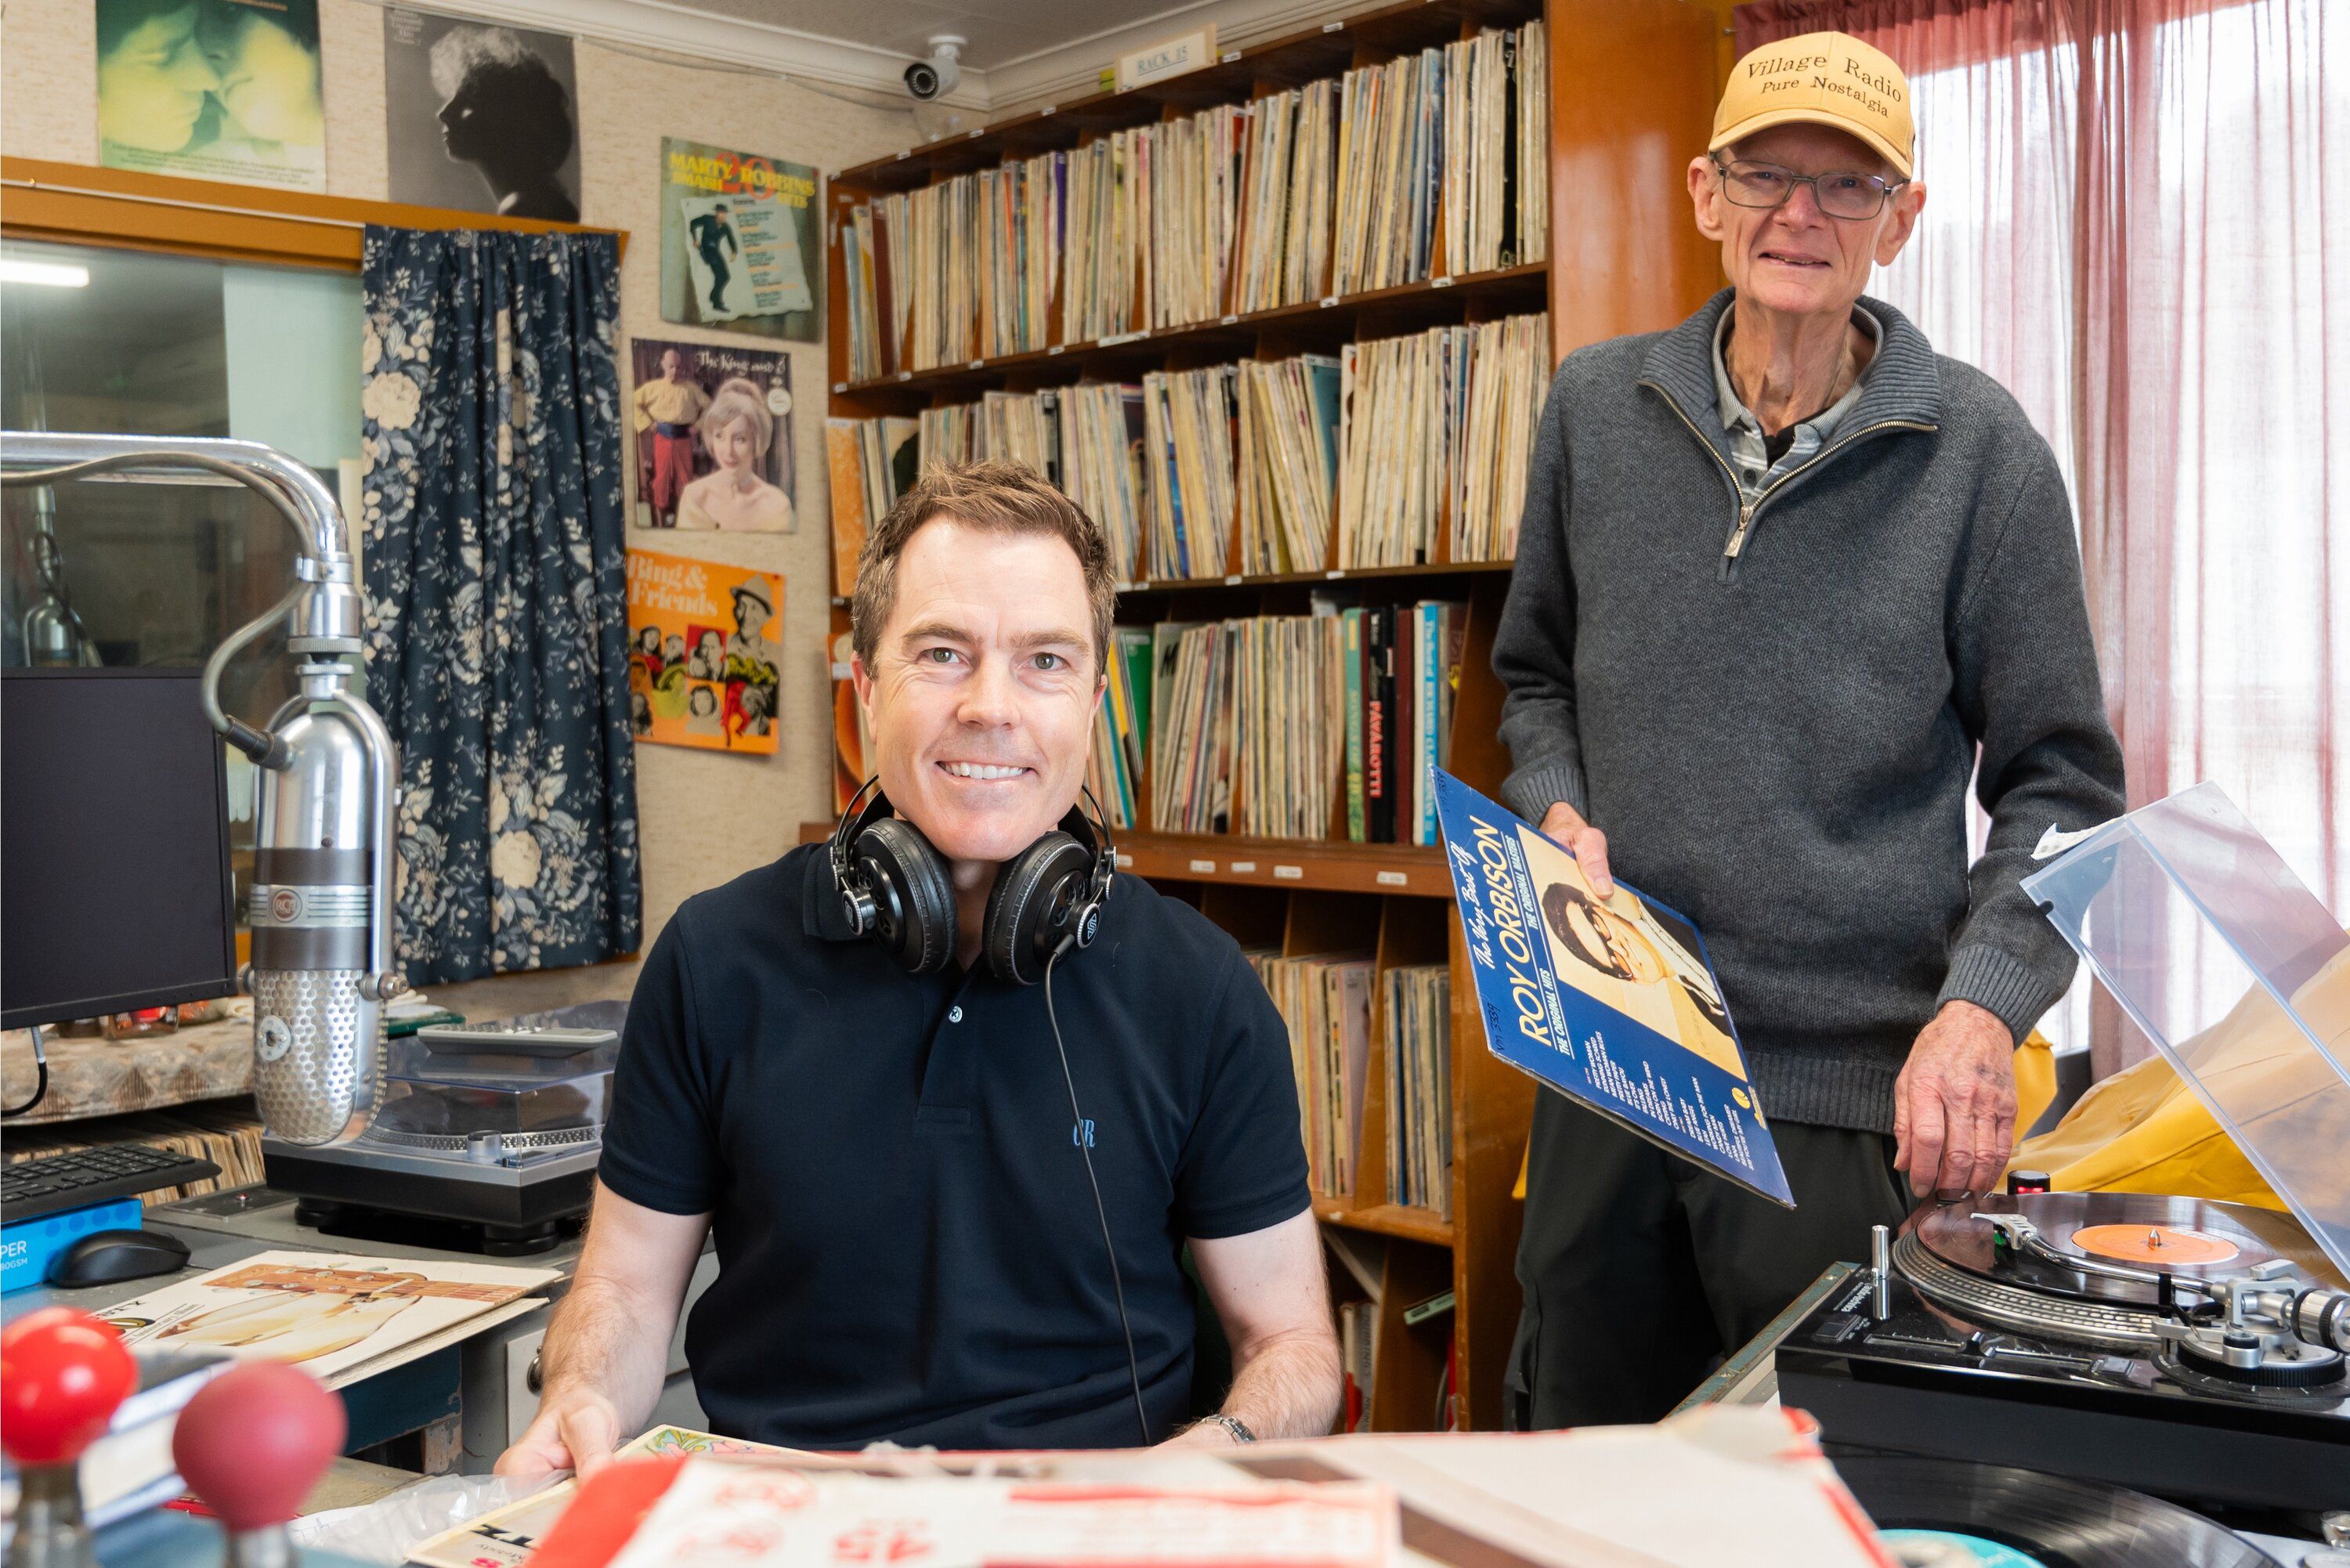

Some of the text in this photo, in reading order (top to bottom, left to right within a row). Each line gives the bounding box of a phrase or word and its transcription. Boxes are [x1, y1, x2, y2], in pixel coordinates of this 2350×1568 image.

[1748, 56, 1902, 103] Village Radio
[1761, 76, 1889, 117] Pure Nostalgia
[670, 151, 815, 197] MARTY ROBBINS
[694, 350, 719, 369] The
[720, 355, 750, 377] King
[685, 565, 709, 589] &
[631, 580, 718, 616] Friends
[1369, 700, 1383, 798] PAVAROTTI
[1457, 859, 1480, 906] Best
[1505, 834, 1538, 929] THE ORIGINAL MASTERS
[276, 899, 296, 914] RCA
[1467, 906, 1495, 941] Very
[1469, 815, 1551, 1046] ROY ORBISON
[1472, 938, 1495, 969] The
[1485, 1000, 1506, 1035] 3339
[1538, 967, 1570, 1055] THE ORIGINAL HITS
[1584, 1040, 1596, 1068] WOMAN
[1590, 1036, 1601, 1062] SCARED
[1600, 1050, 1611, 1077] WOMAN
[1591, 1067, 1601, 1089] PRETTY
[1614, 1079, 1625, 1101] PRETTY
[1659, 1076, 1670, 1100] LONELY
[1642, 1082, 1654, 1110] DREAMS
[1679, 1097, 1688, 1115] BABY
[1683, 1114, 1696, 1138] DREAM
[1687, 1104, 1703, 1142] BLUE ANGEL
[1723, 1104, 1737, 1134] DREAMER
[1701, 1129, 1711, 1146] LEAH
[1714, 1129, 1726, 1154] CANDY
[1723, 1140, 1733, 1158] LOVE
